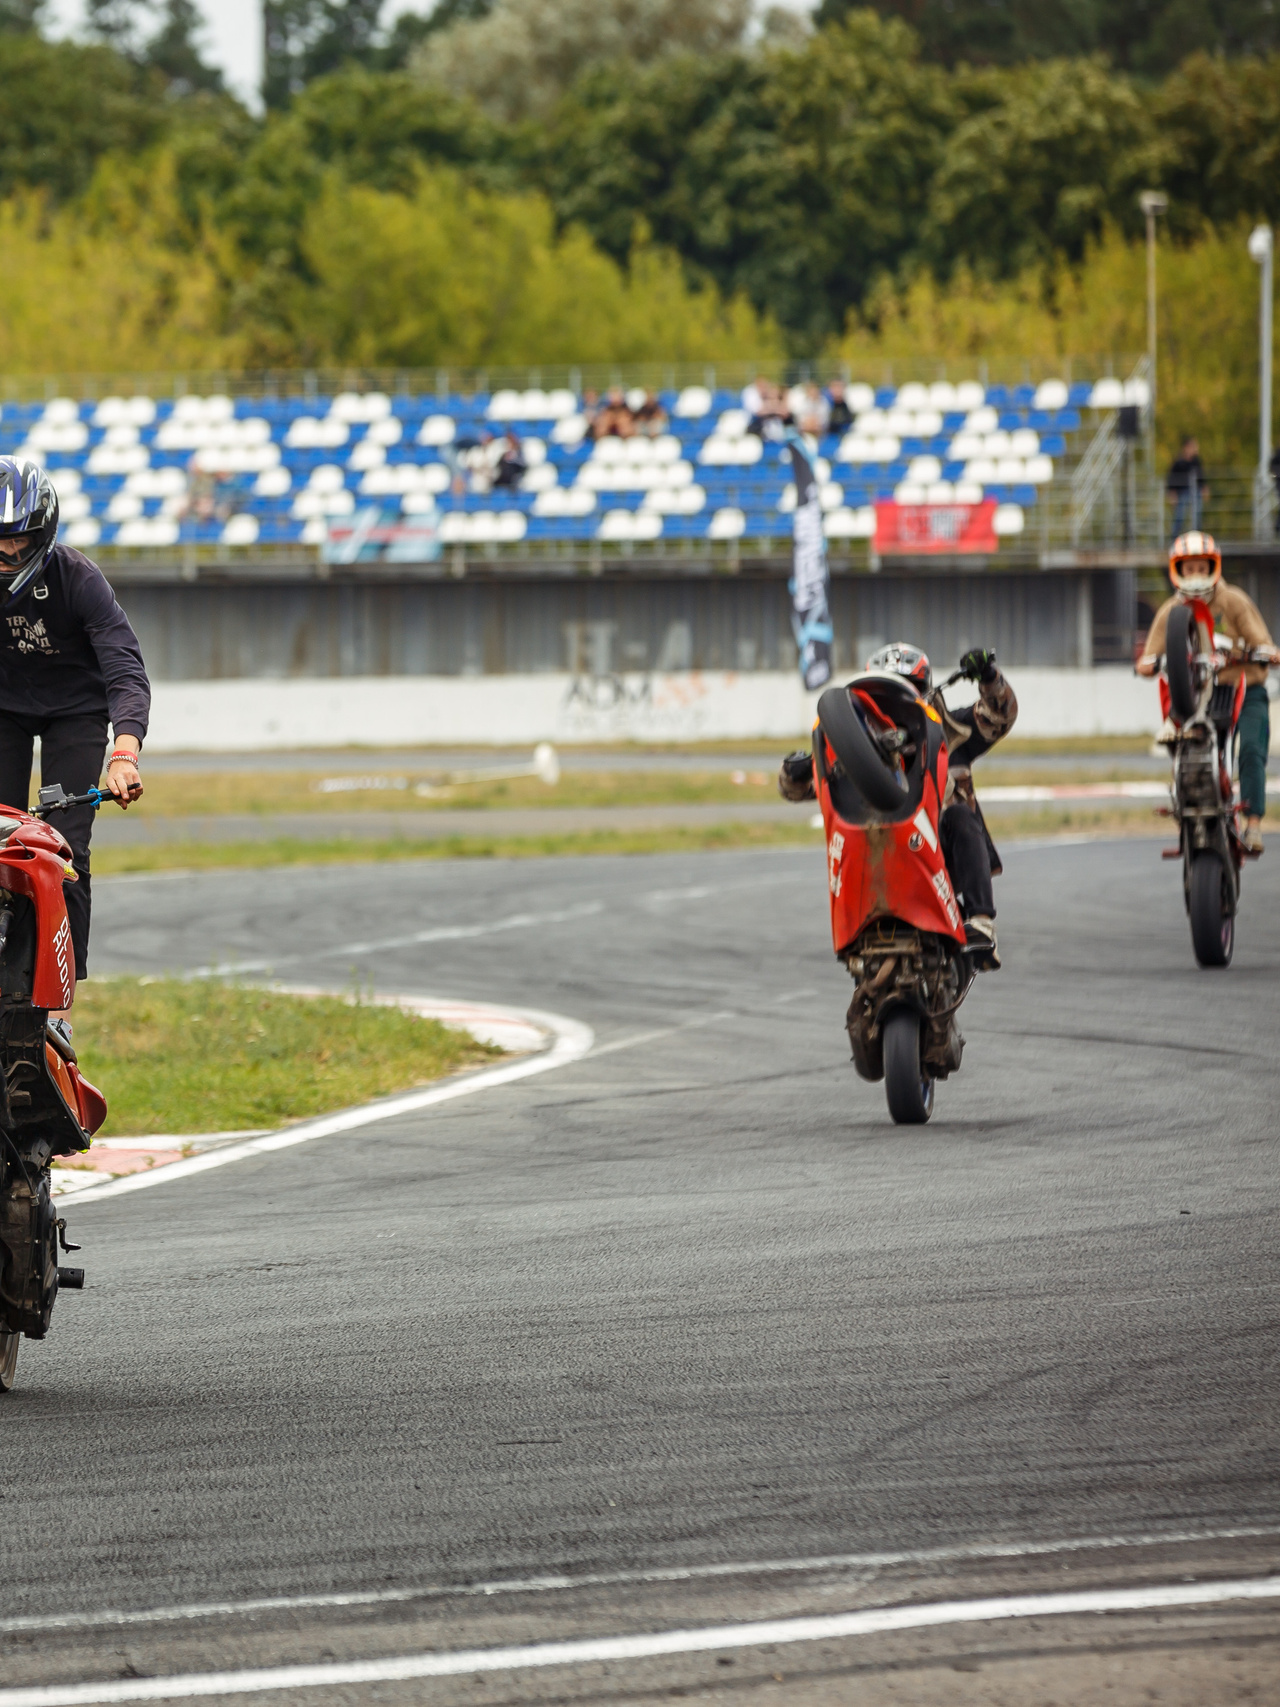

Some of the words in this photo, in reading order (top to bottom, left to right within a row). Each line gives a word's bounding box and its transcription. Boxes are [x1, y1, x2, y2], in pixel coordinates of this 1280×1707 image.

[12, 628, 20, 637] И
[60, 916, 70, 951] DL
[53, 930, 70, 1008] AUDIO
